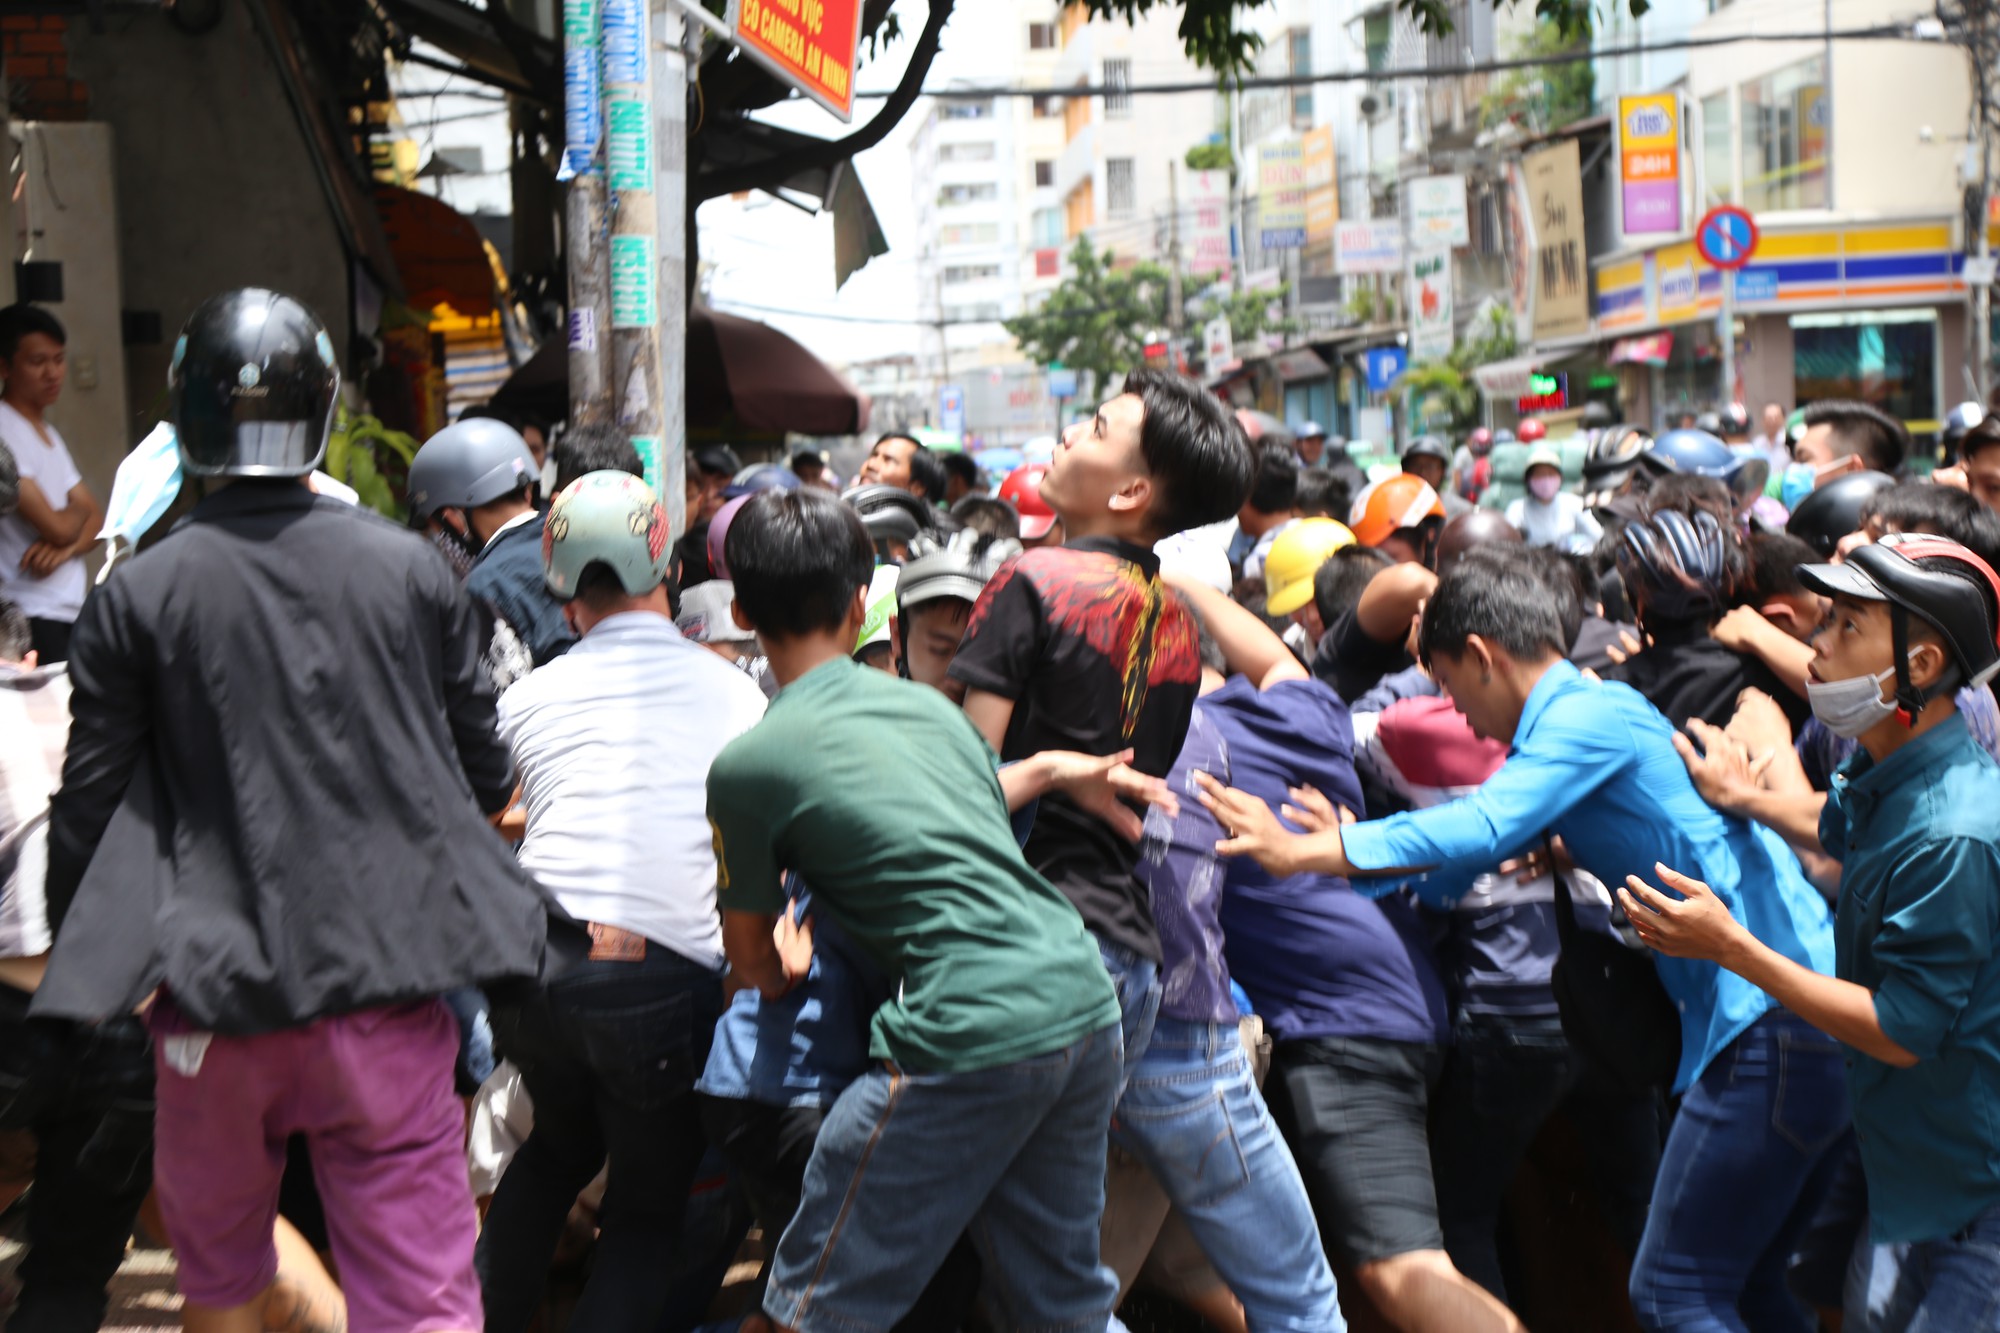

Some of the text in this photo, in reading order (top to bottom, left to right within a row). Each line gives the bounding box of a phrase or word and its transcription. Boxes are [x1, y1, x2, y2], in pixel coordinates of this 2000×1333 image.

[760, 7, 805, 69] CAMERA
[804, 42, 821, 79] AN
[820, 53, 848, 100] NINH
